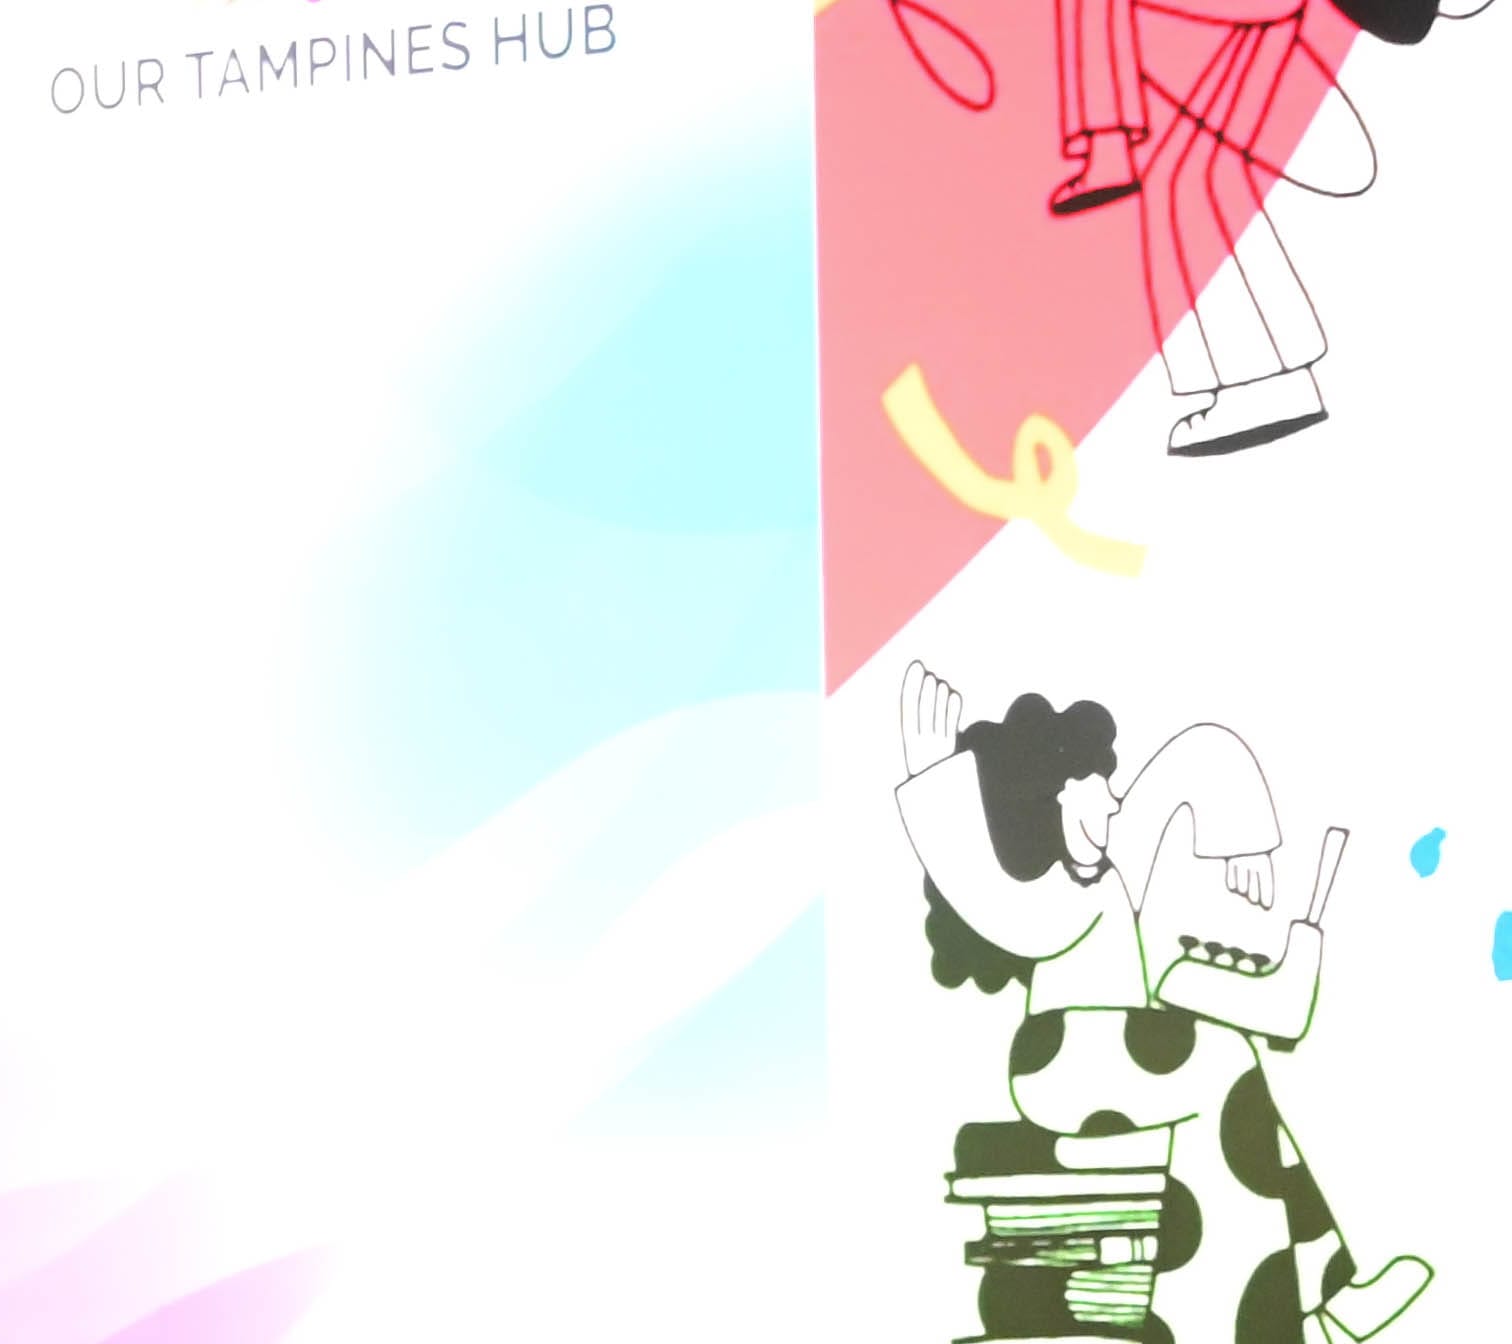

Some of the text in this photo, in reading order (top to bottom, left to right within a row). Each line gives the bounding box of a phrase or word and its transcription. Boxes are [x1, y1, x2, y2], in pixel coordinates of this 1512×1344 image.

[50, 3, 618, 114] OUR TAMPINES HUB
